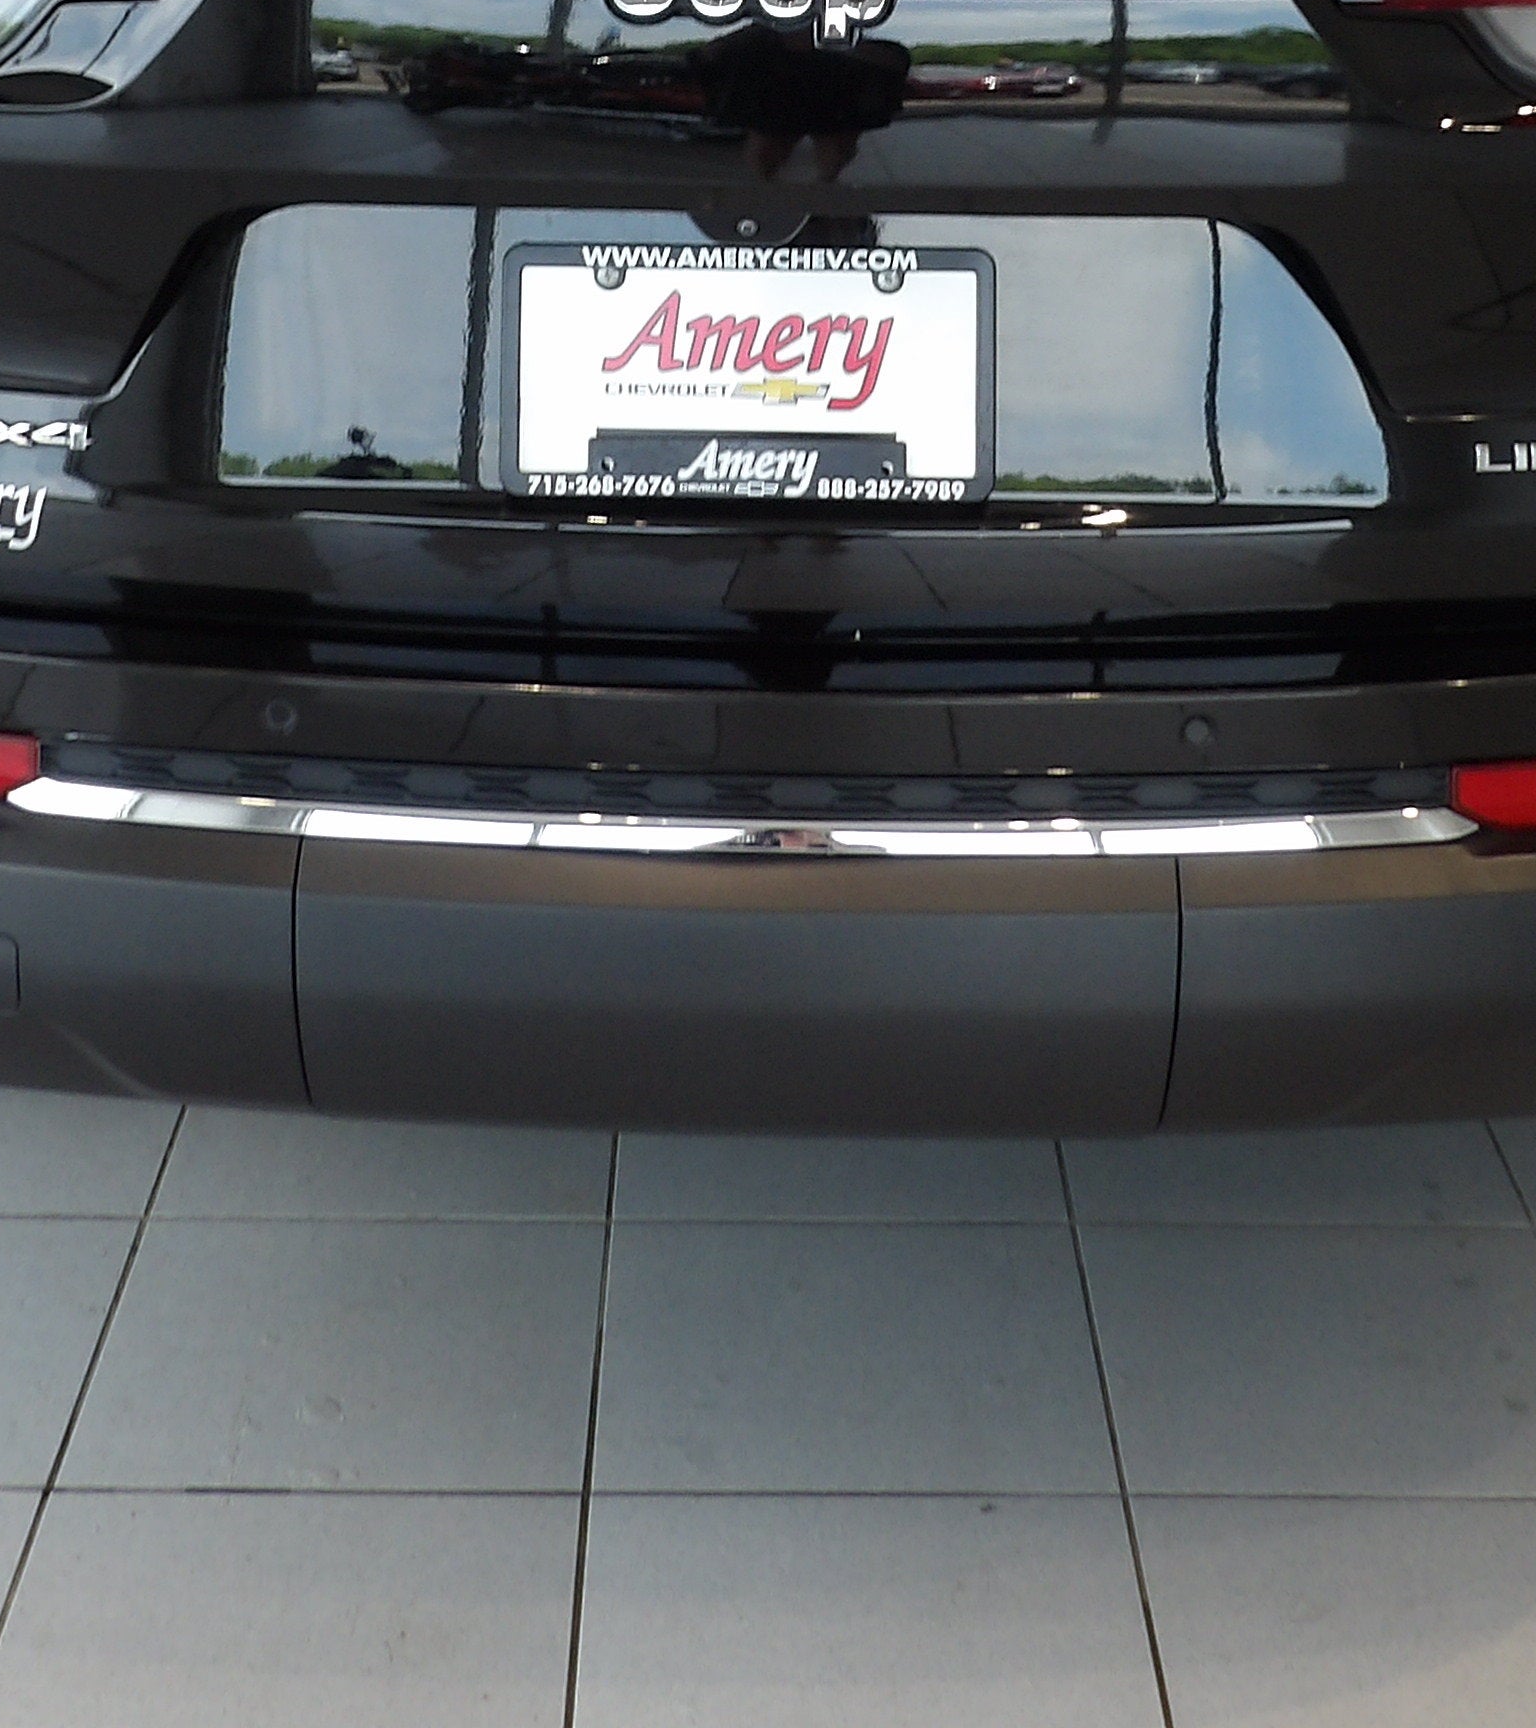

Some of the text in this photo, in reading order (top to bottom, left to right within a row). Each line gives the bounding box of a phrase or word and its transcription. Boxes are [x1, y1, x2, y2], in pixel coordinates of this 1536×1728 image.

[581, 245, 918, 271] WWW.AMERYCHEV.COM
[602, 289, 895, 411] Amery
[604, 382, 730, 398] CHEVROLET
[677, 438, 819, 499] Amery
